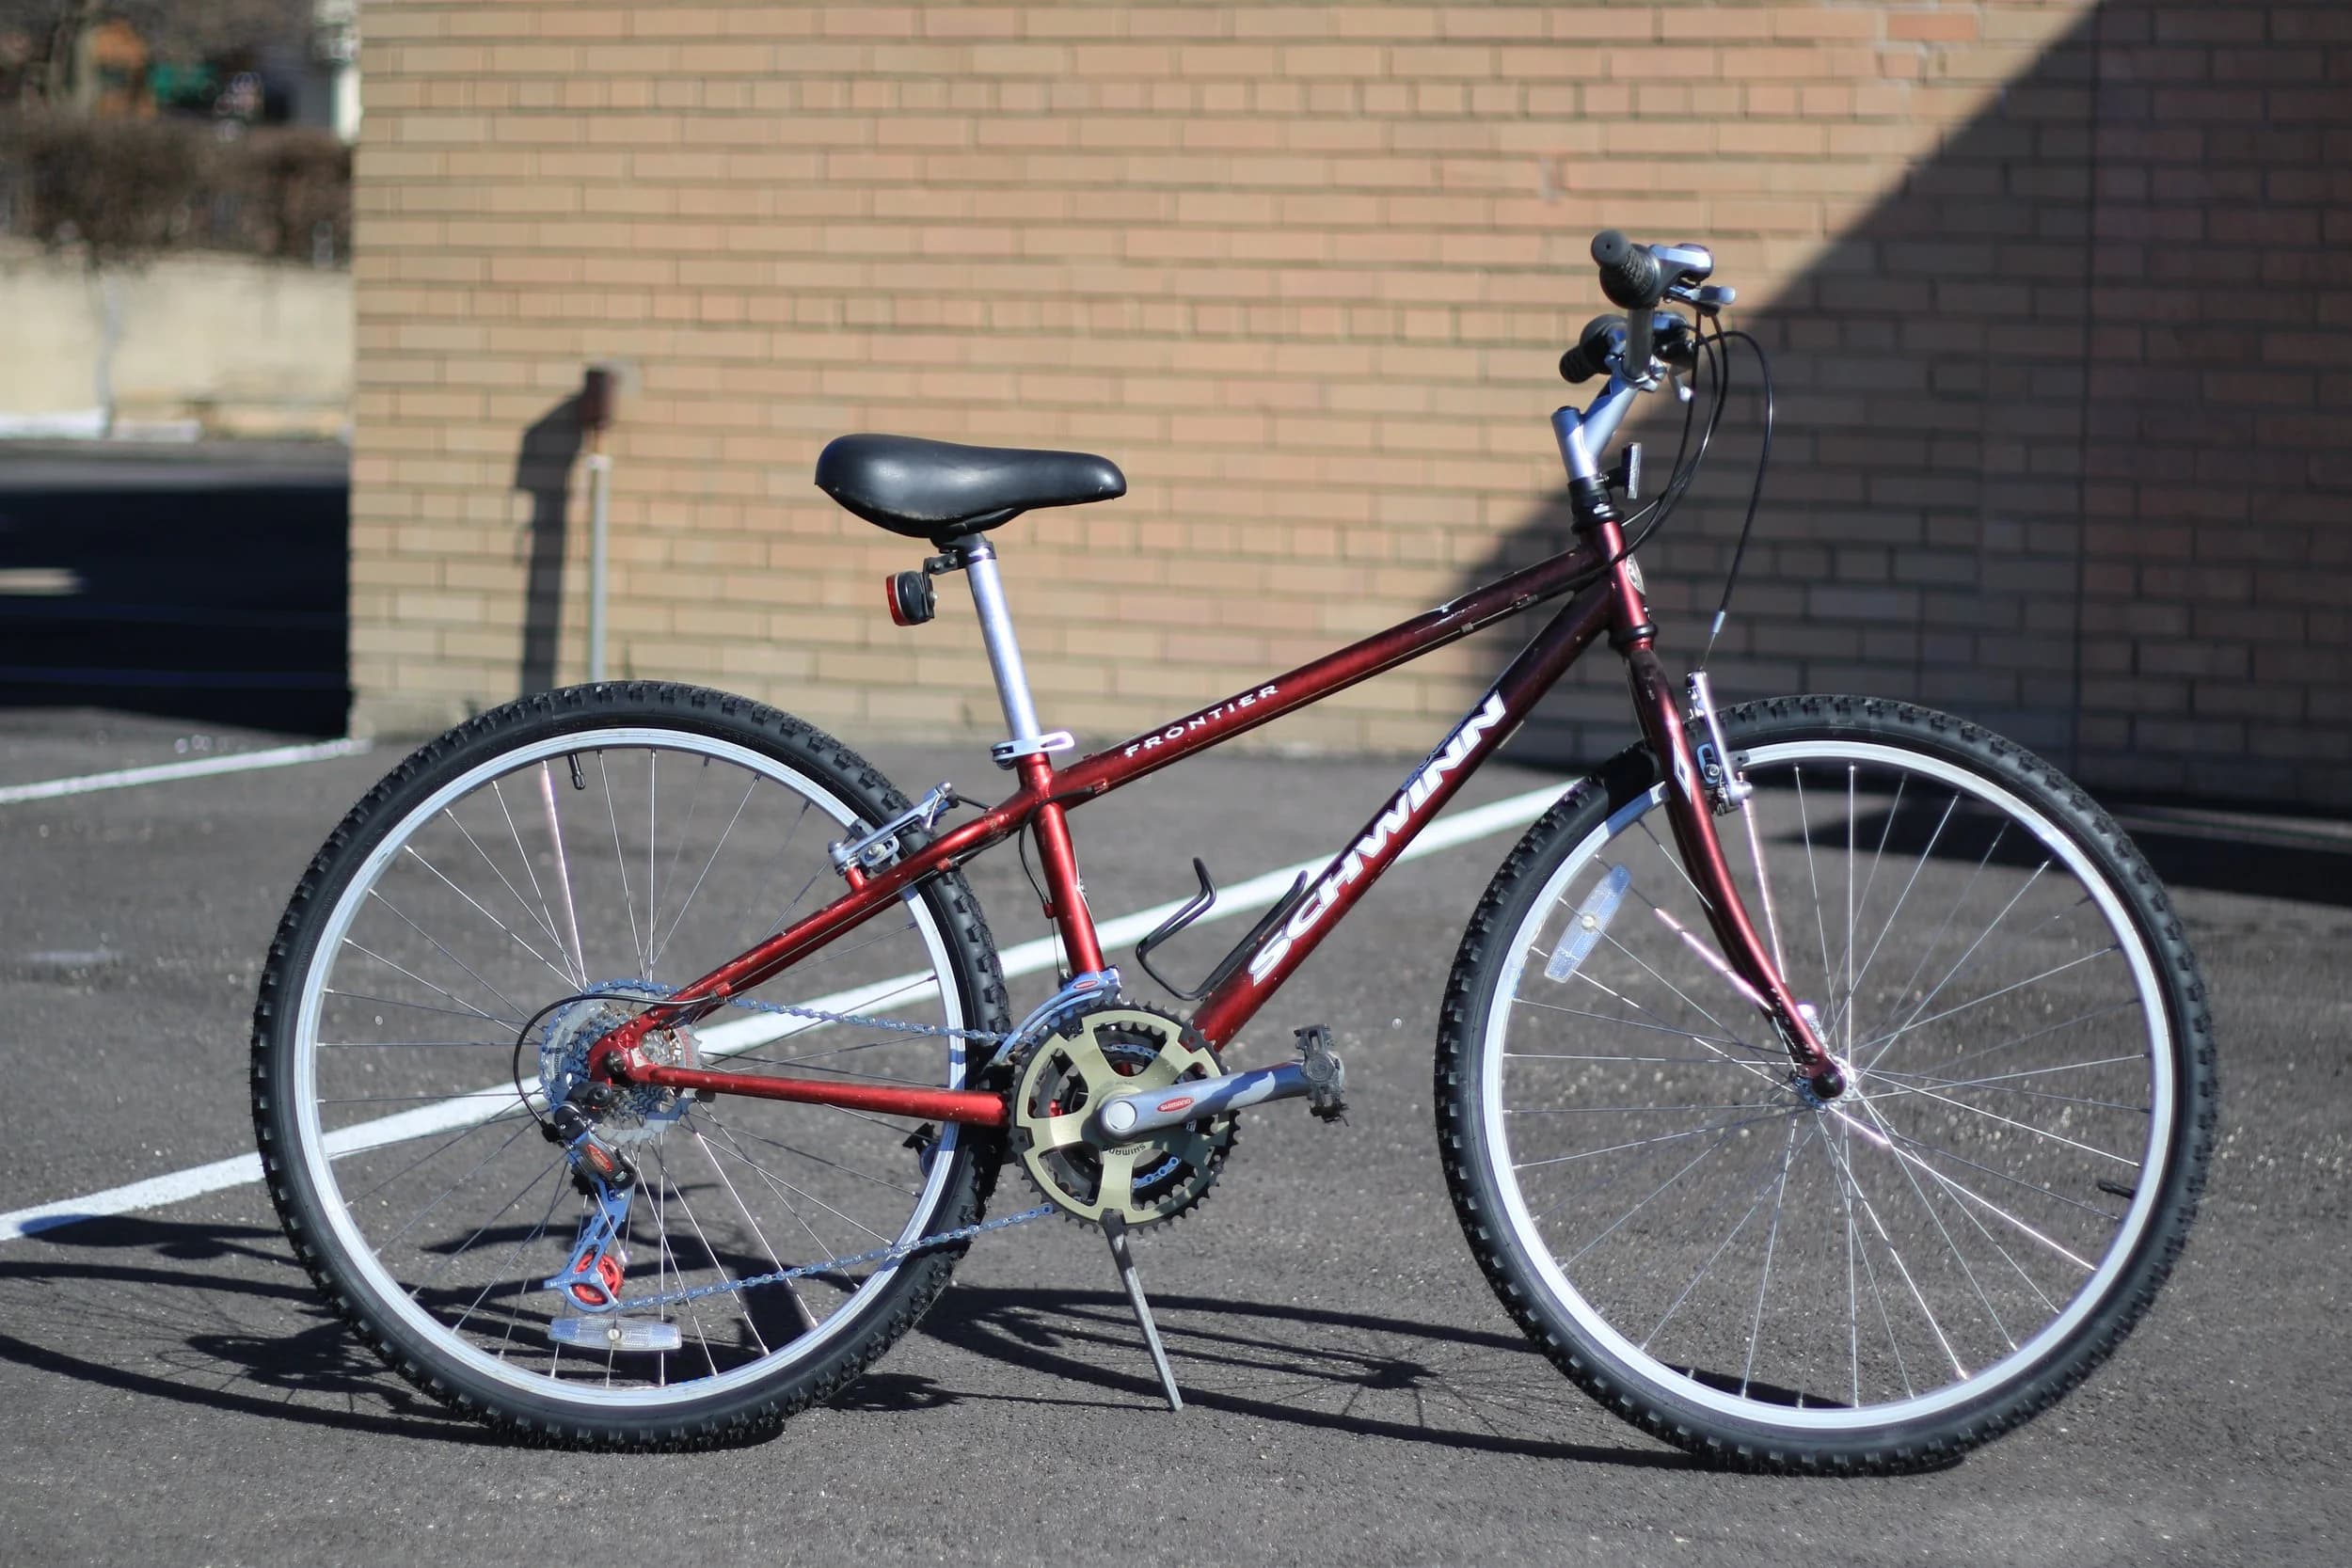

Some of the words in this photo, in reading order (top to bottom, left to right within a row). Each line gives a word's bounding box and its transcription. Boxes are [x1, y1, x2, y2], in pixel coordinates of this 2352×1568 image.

[1124, 684, 1279, 758] FRONTIER
[1248, 690, 1506, 987] SCHWINN
[1160, 1098, 1192, 1111] SHIMANO
